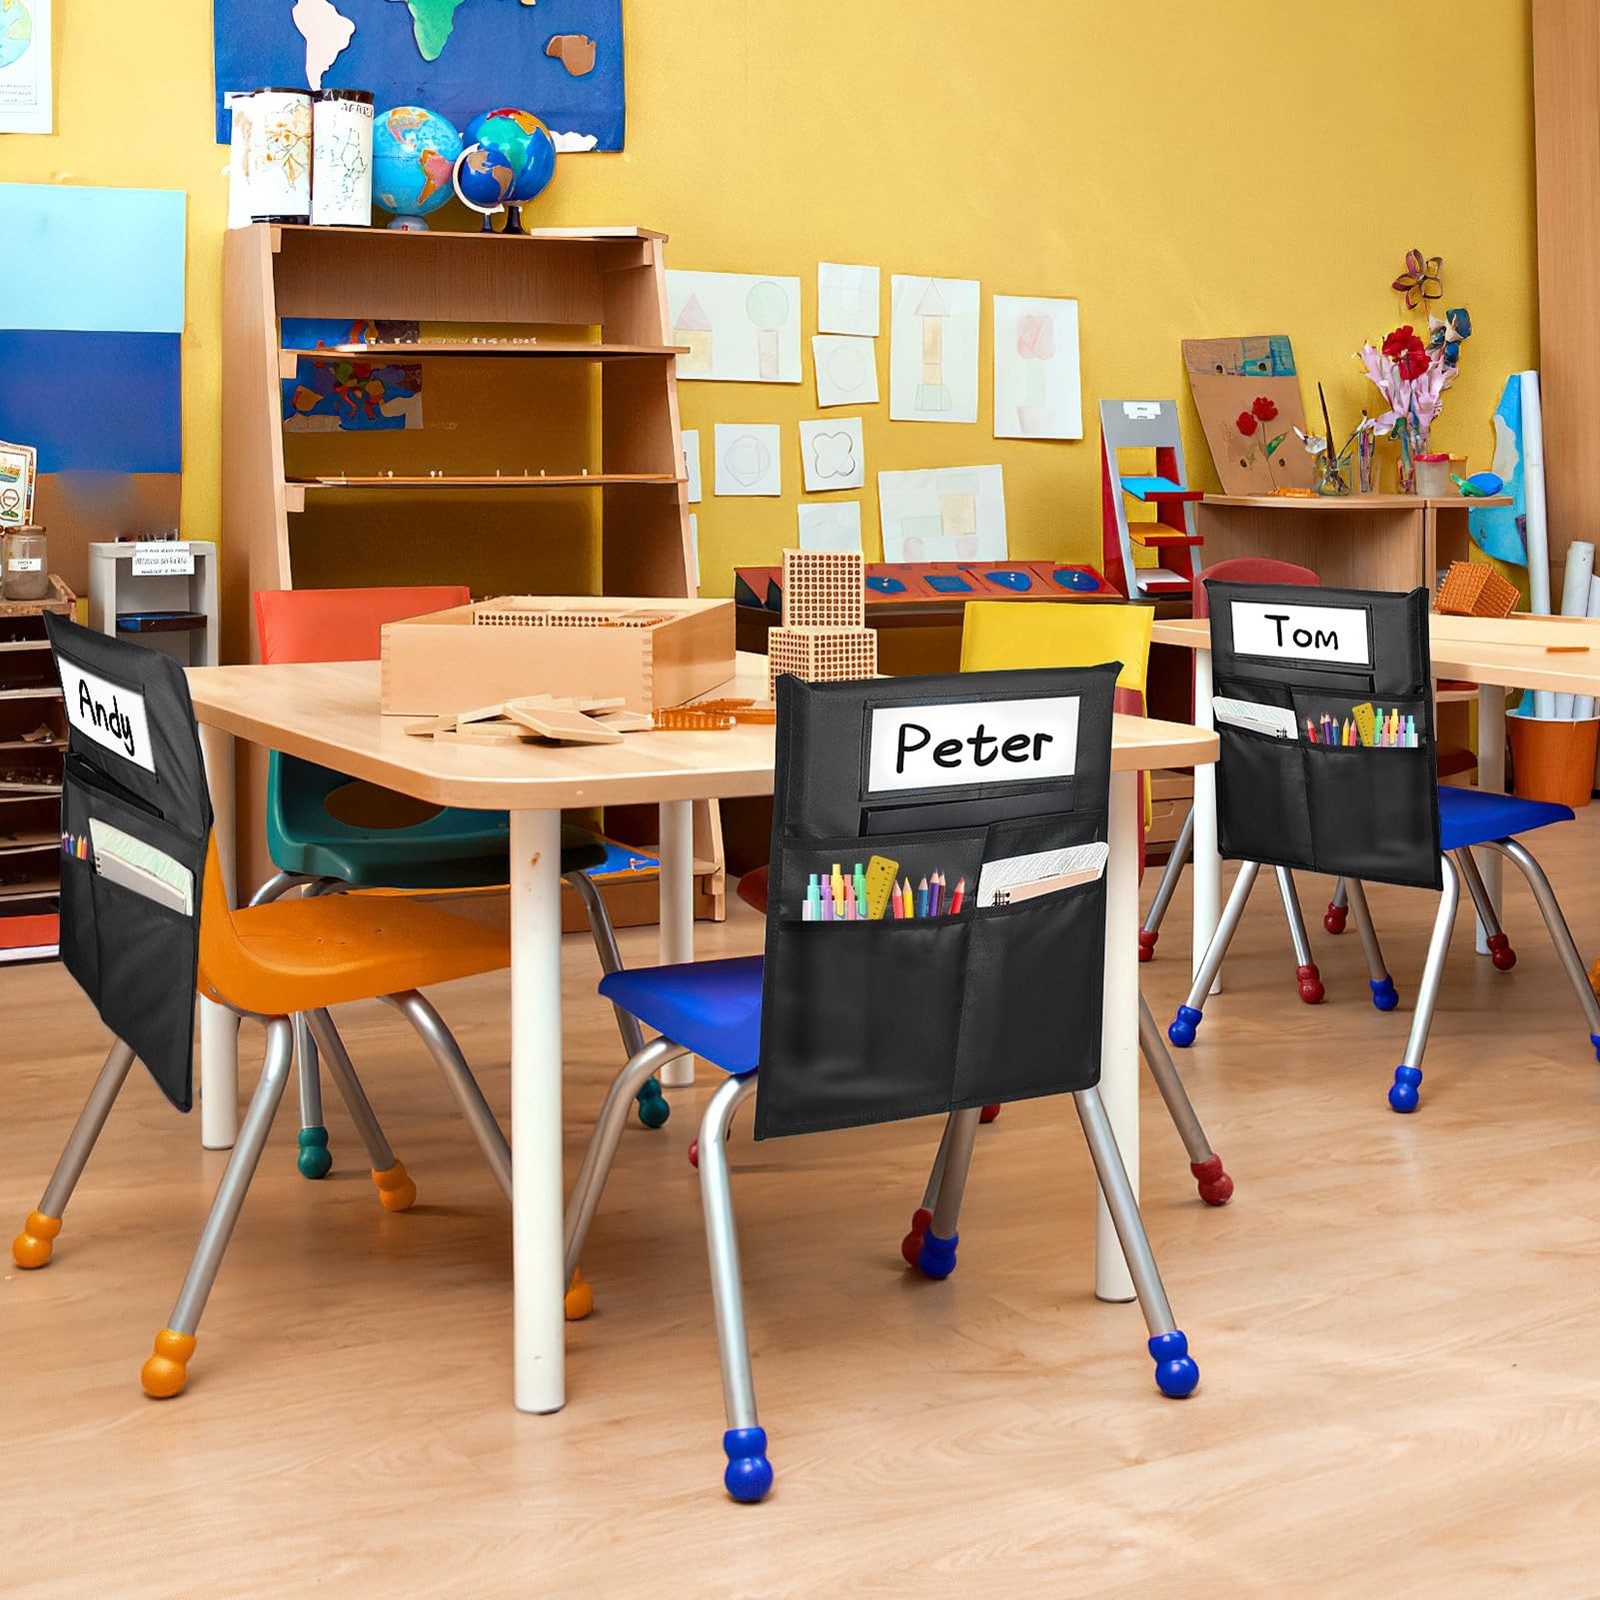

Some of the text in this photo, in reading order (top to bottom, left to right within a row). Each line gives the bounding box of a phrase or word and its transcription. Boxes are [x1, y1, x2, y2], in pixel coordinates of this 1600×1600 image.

[1264, 614, 1339, 651] Tom
[78, 679, 135, 757] Andy
[896, 723, 1054, 774] Peter
